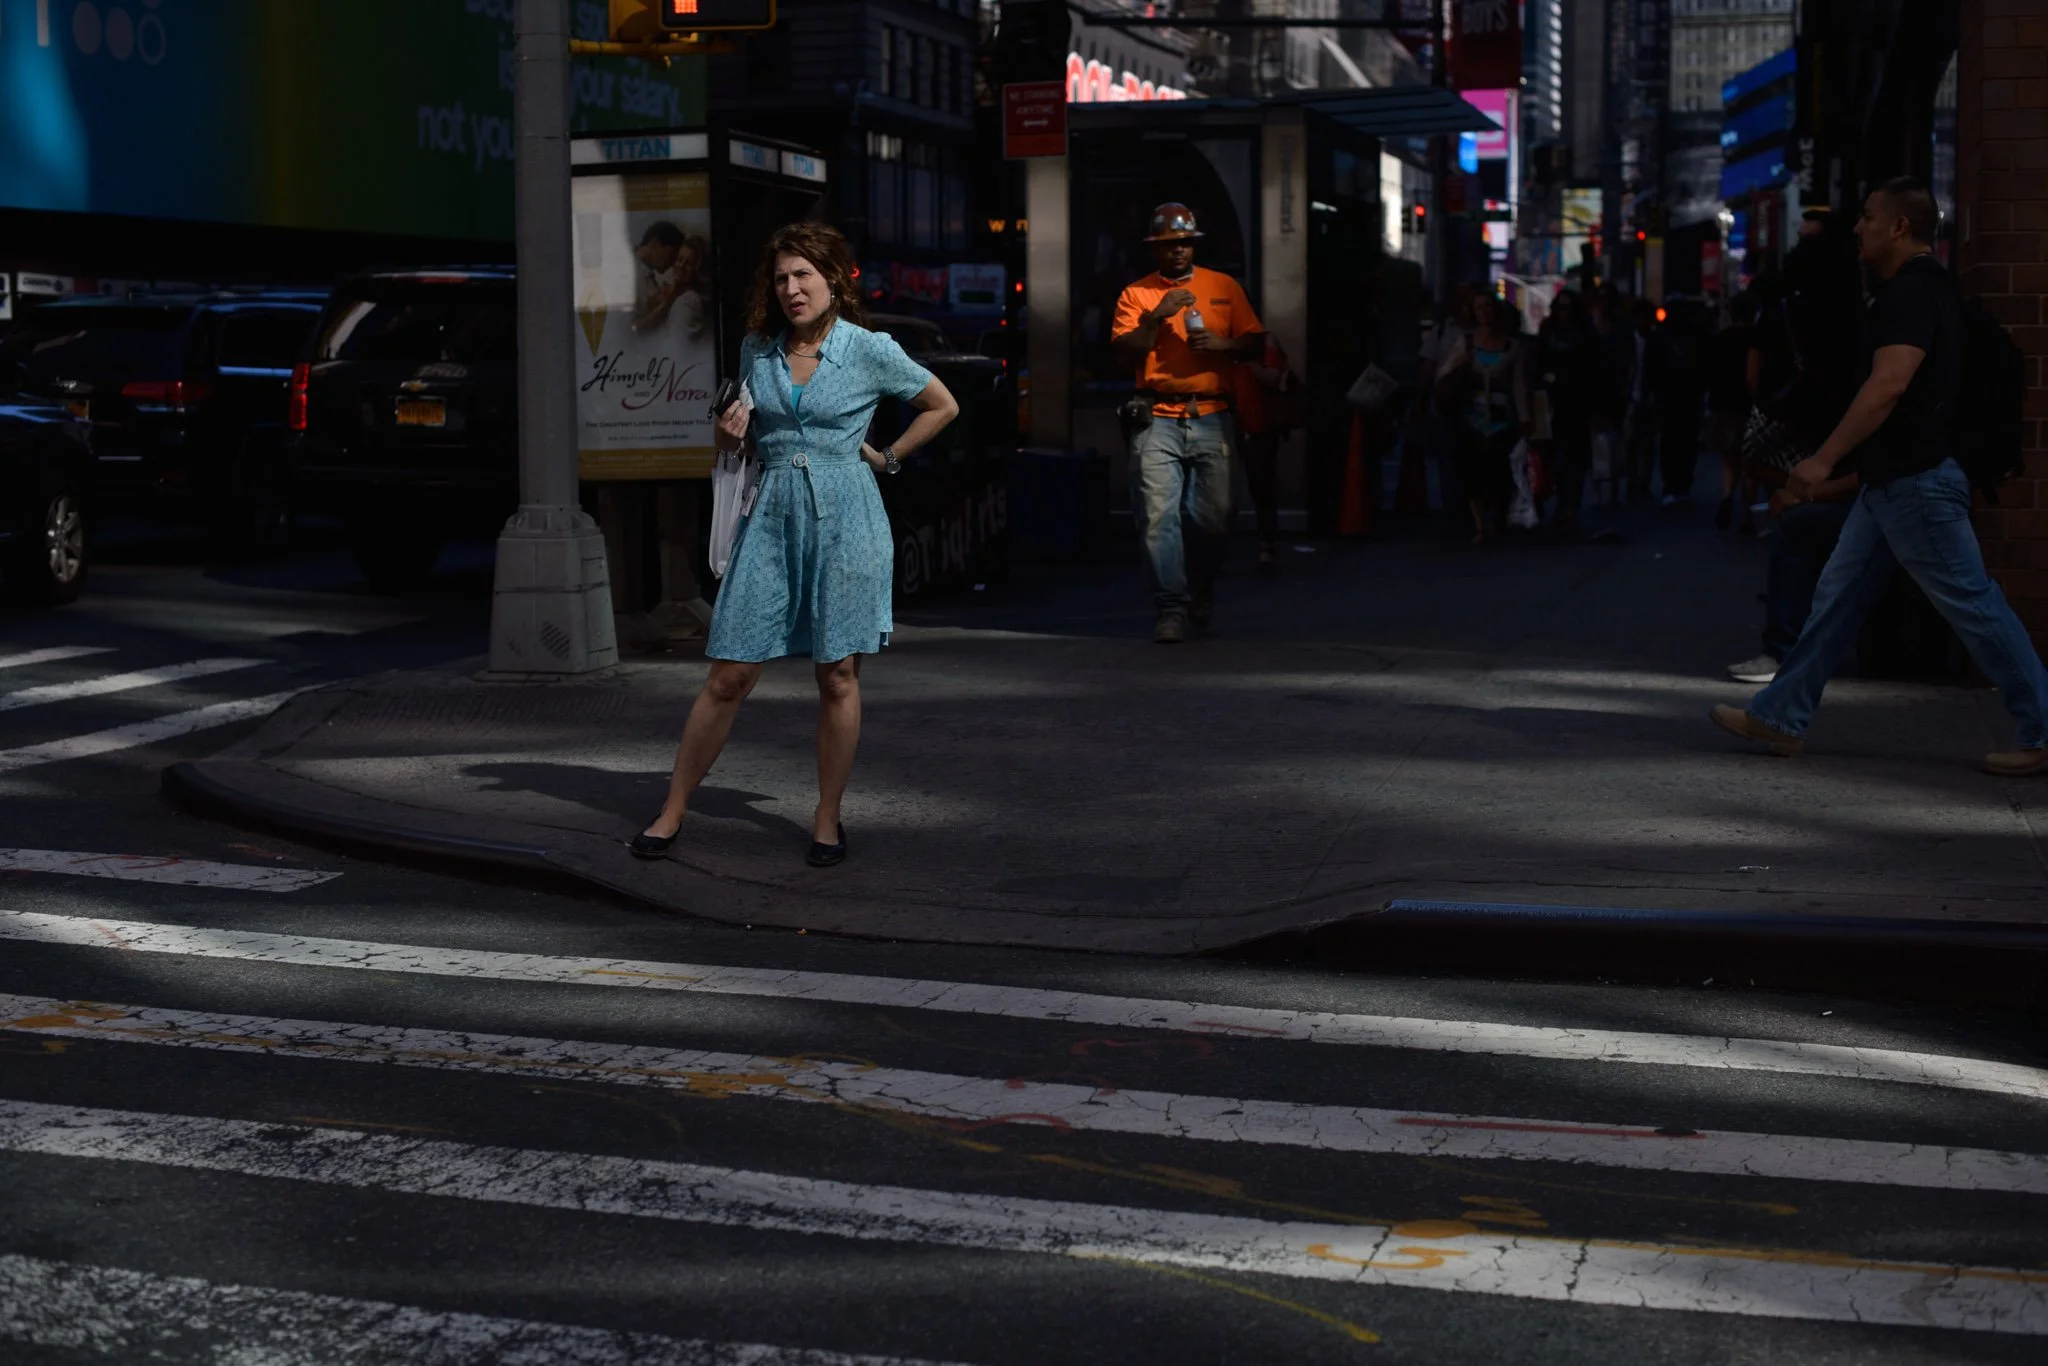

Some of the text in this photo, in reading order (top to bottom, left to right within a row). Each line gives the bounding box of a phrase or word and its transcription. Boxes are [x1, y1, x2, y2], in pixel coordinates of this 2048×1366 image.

[417, 98, 468, 154] not
[602, 136, 671, 161] TITAN
[581, 350, 670, 392] Himself
[621, 361, 712, 411] Nora
